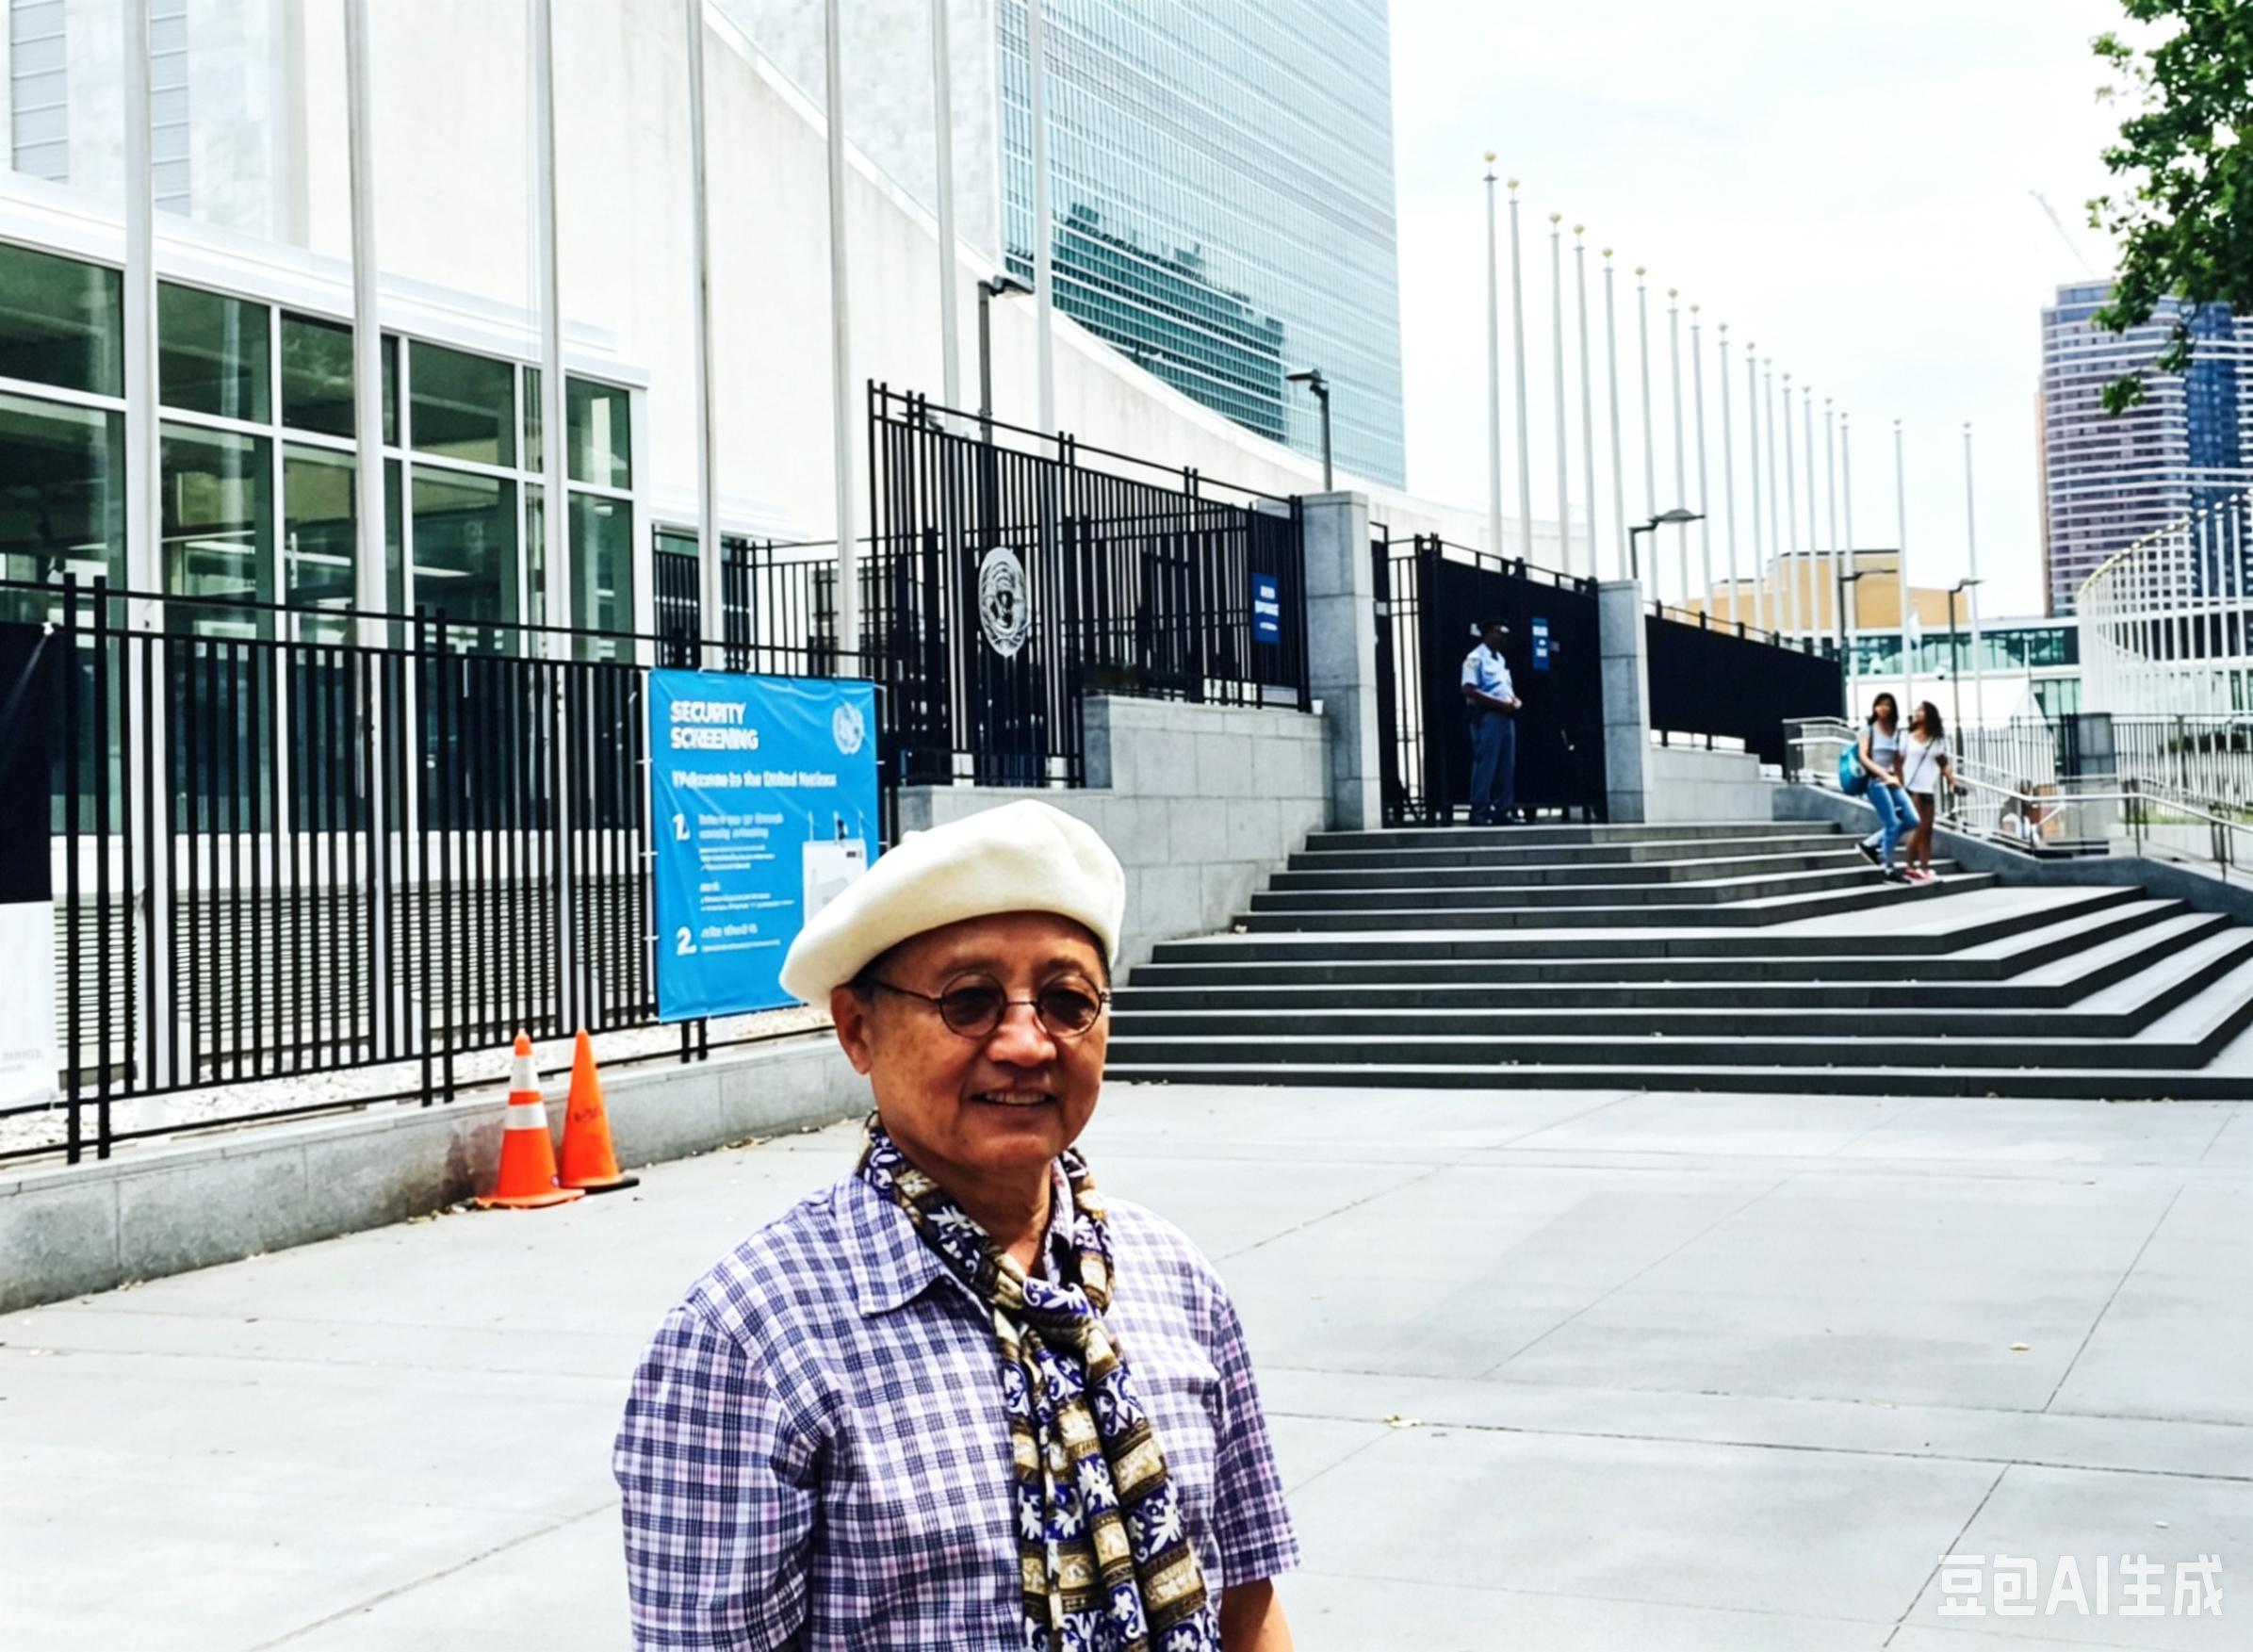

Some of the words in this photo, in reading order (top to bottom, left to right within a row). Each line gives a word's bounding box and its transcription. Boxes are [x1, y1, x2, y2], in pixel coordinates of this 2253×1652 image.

[671, 701, 746, 725] SECURITY
[671, 728, 759, 750] SCREENING
[677, 927, 697, 956] 2
